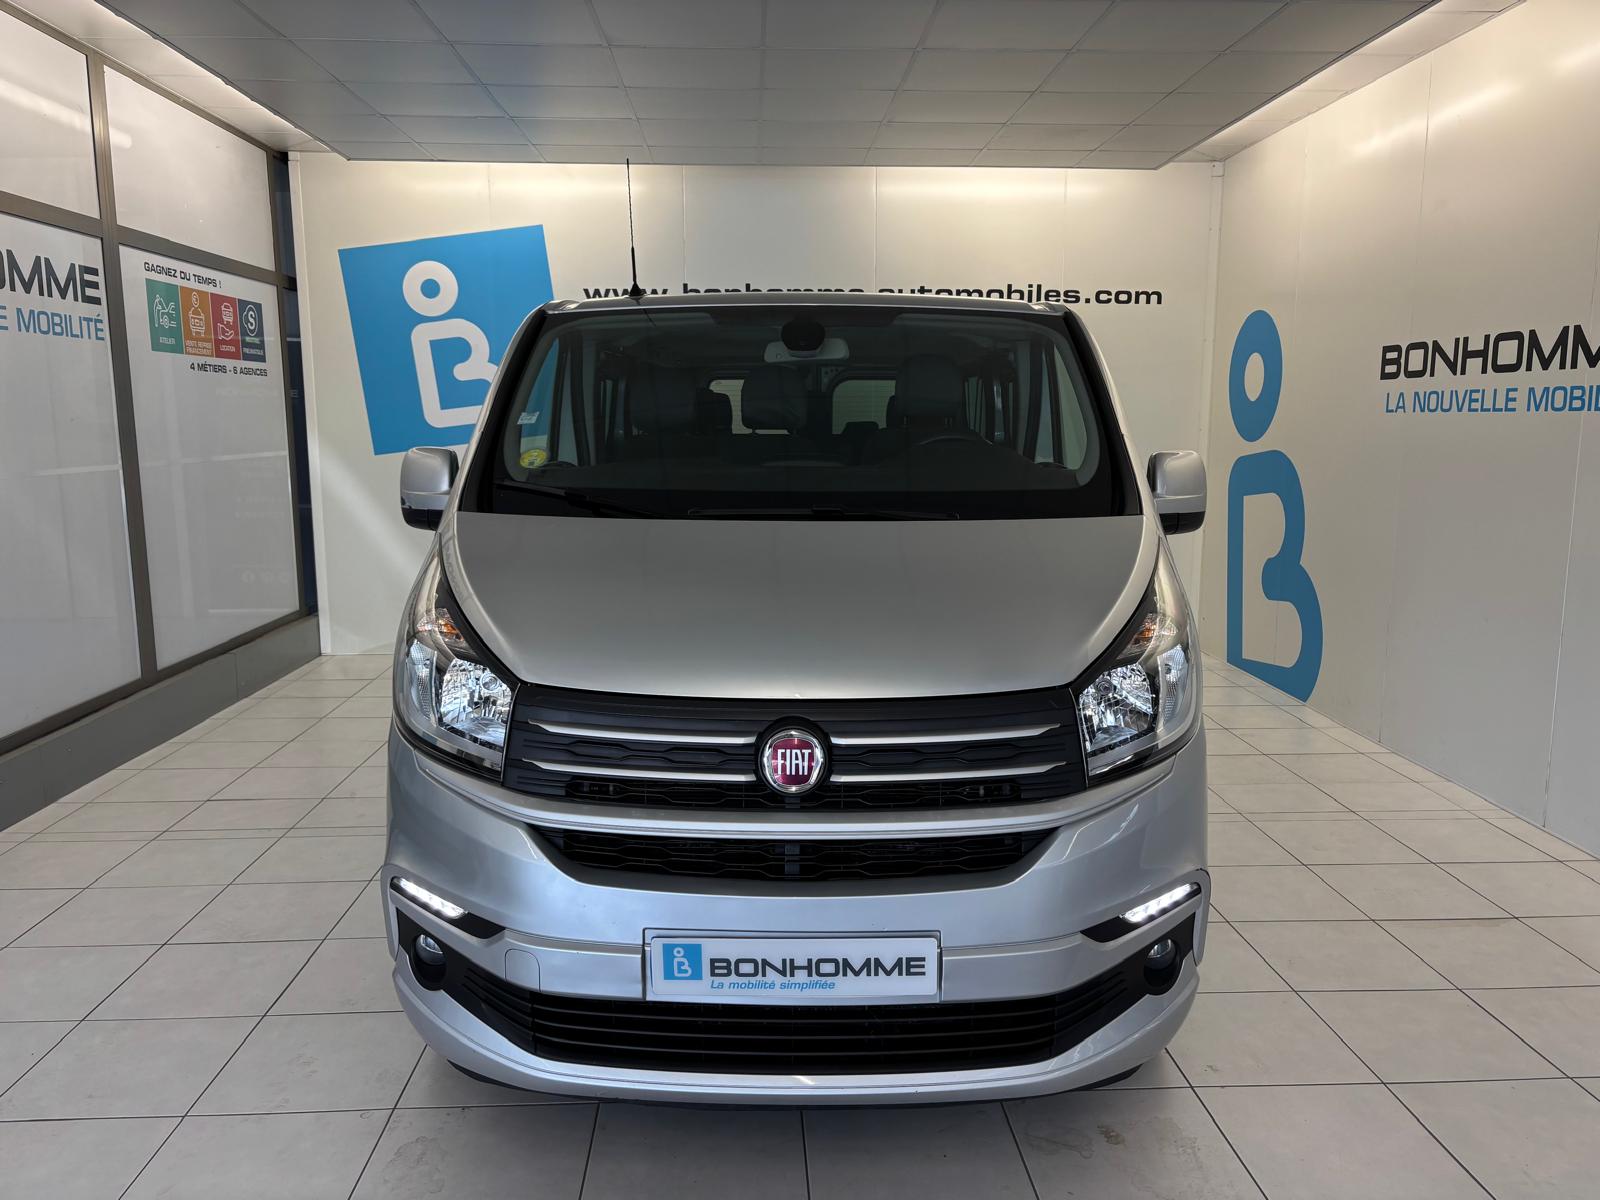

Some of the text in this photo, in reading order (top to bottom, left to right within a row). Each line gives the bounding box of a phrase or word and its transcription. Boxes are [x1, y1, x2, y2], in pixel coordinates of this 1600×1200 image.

[0, 249, 102, 305] MME
[143, 262, 178, 278] GAGNEZ
[179, 270, 191, 281] DU
[192, 273, 218, 288] TEMPS
[15, 307, 105, 341] MOBILITÉ
[1380, 324, 1600, 380] BONHOMM
[189, 362, 195, 371] 4
[197, 361, 228, 374] MÉTIERS
[233, 366, 238, 374] 6
[239, 368, 268, 377] AGENCES
[1385, 392, 1406, 413] LA
[1412, 387, 1518, 413] NOUVELLE
[777, 749, 812, 776] FIAT
[709, 957, 927, 978] BONHOMME
[710, 979, 836, 992] La mobilité simplifiée
